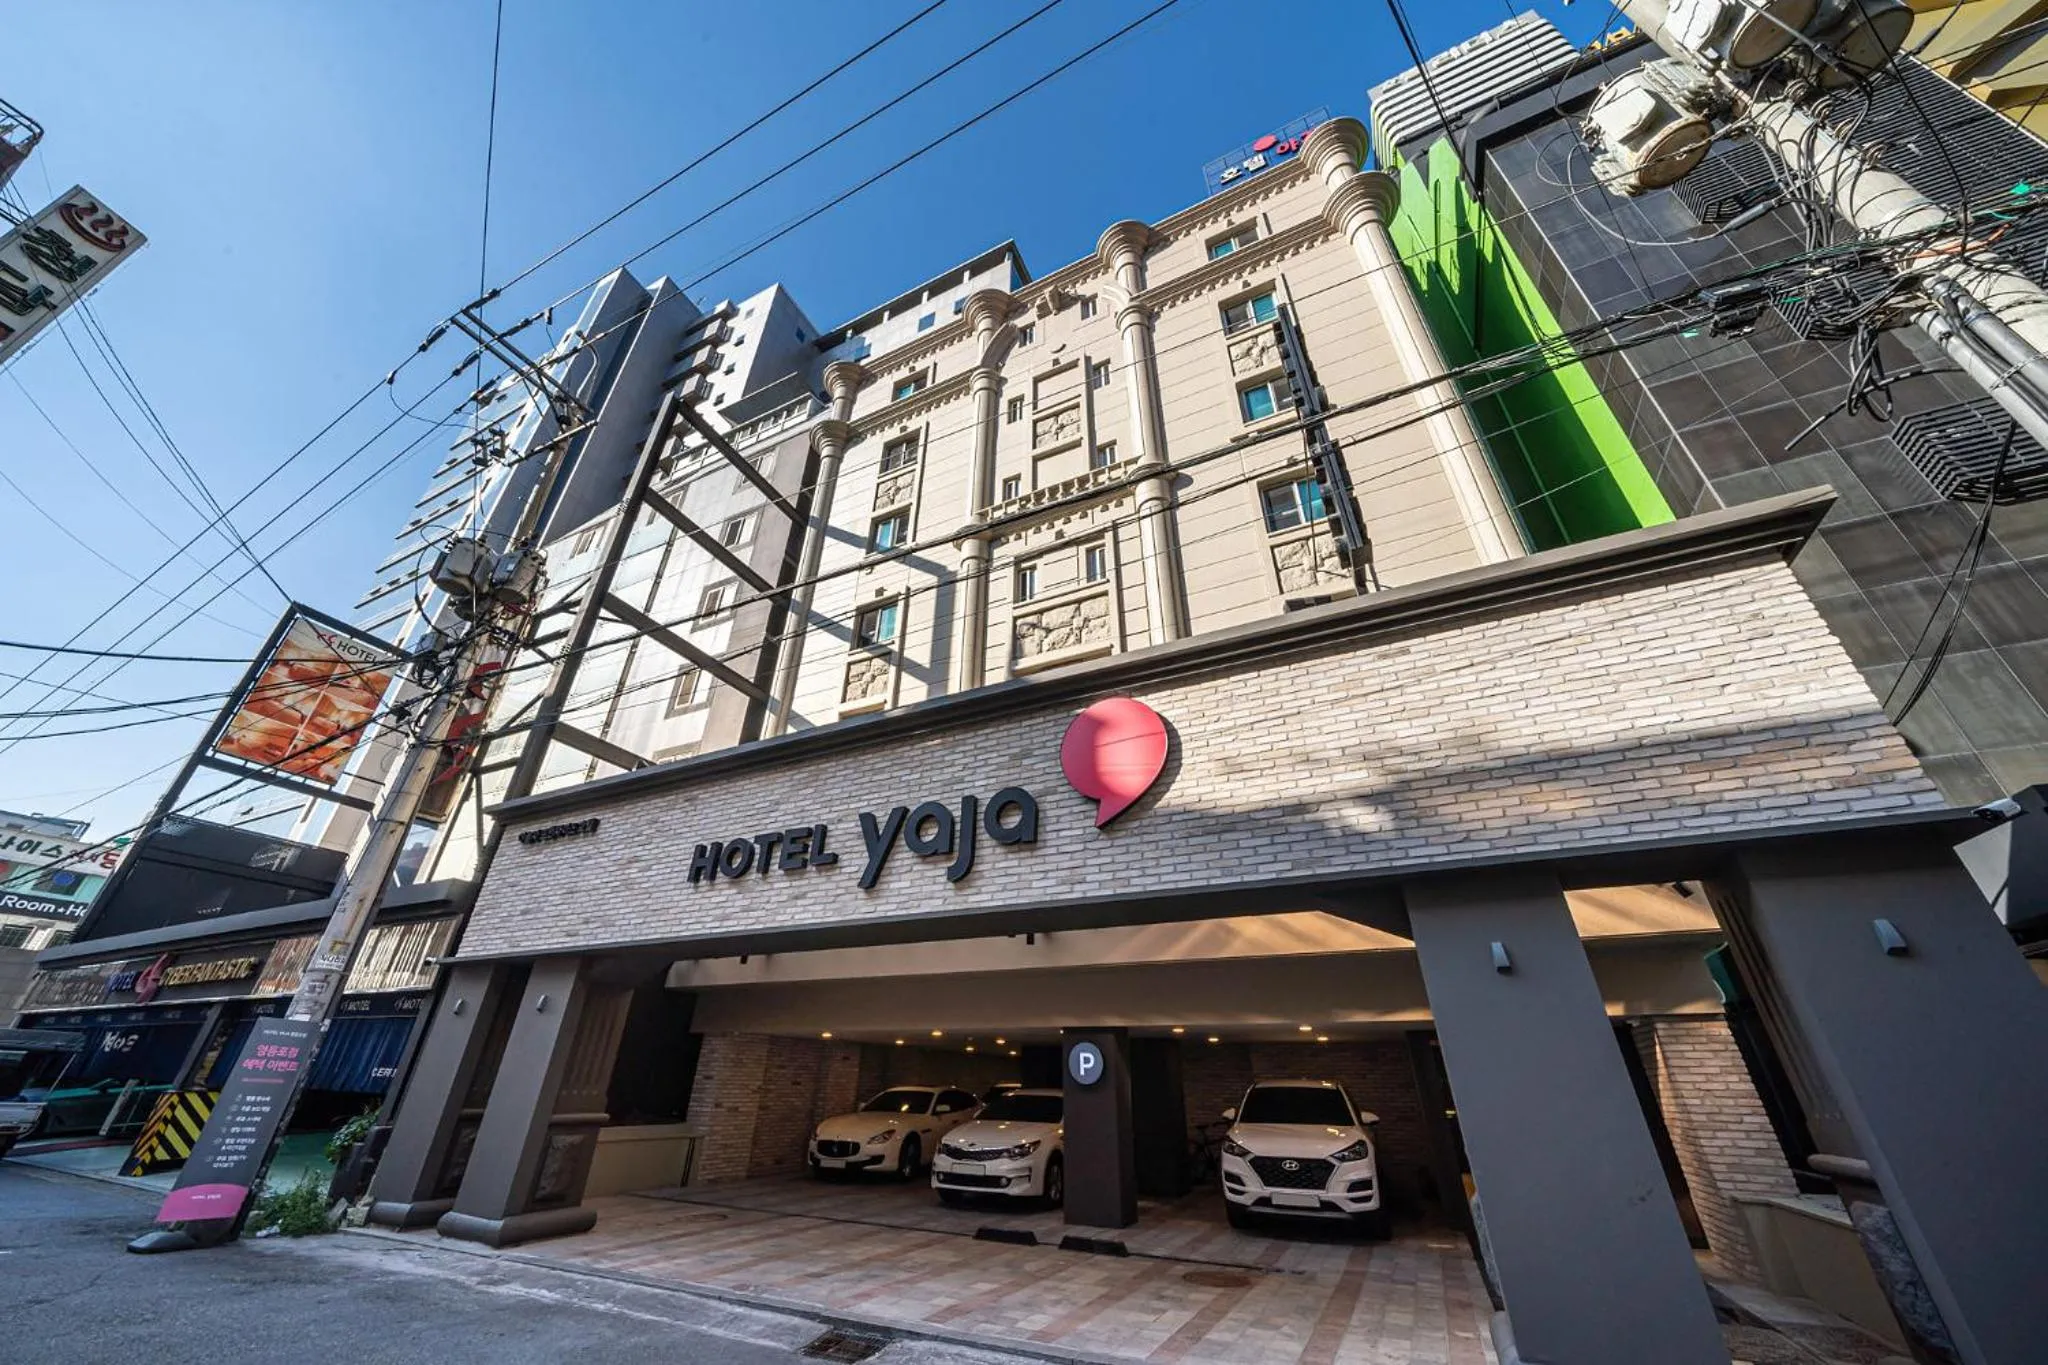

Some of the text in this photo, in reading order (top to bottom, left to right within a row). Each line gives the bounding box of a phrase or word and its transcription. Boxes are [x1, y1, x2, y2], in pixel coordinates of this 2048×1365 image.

[1275, 128, 1315, 155] 야
[687, 786, 1040, 890] HOTEL yaja
[0, 894, 56, 914] Room
[266, 1059, 300, 1073] 이벤트
[1078, 1052, 1096, 1077] P
